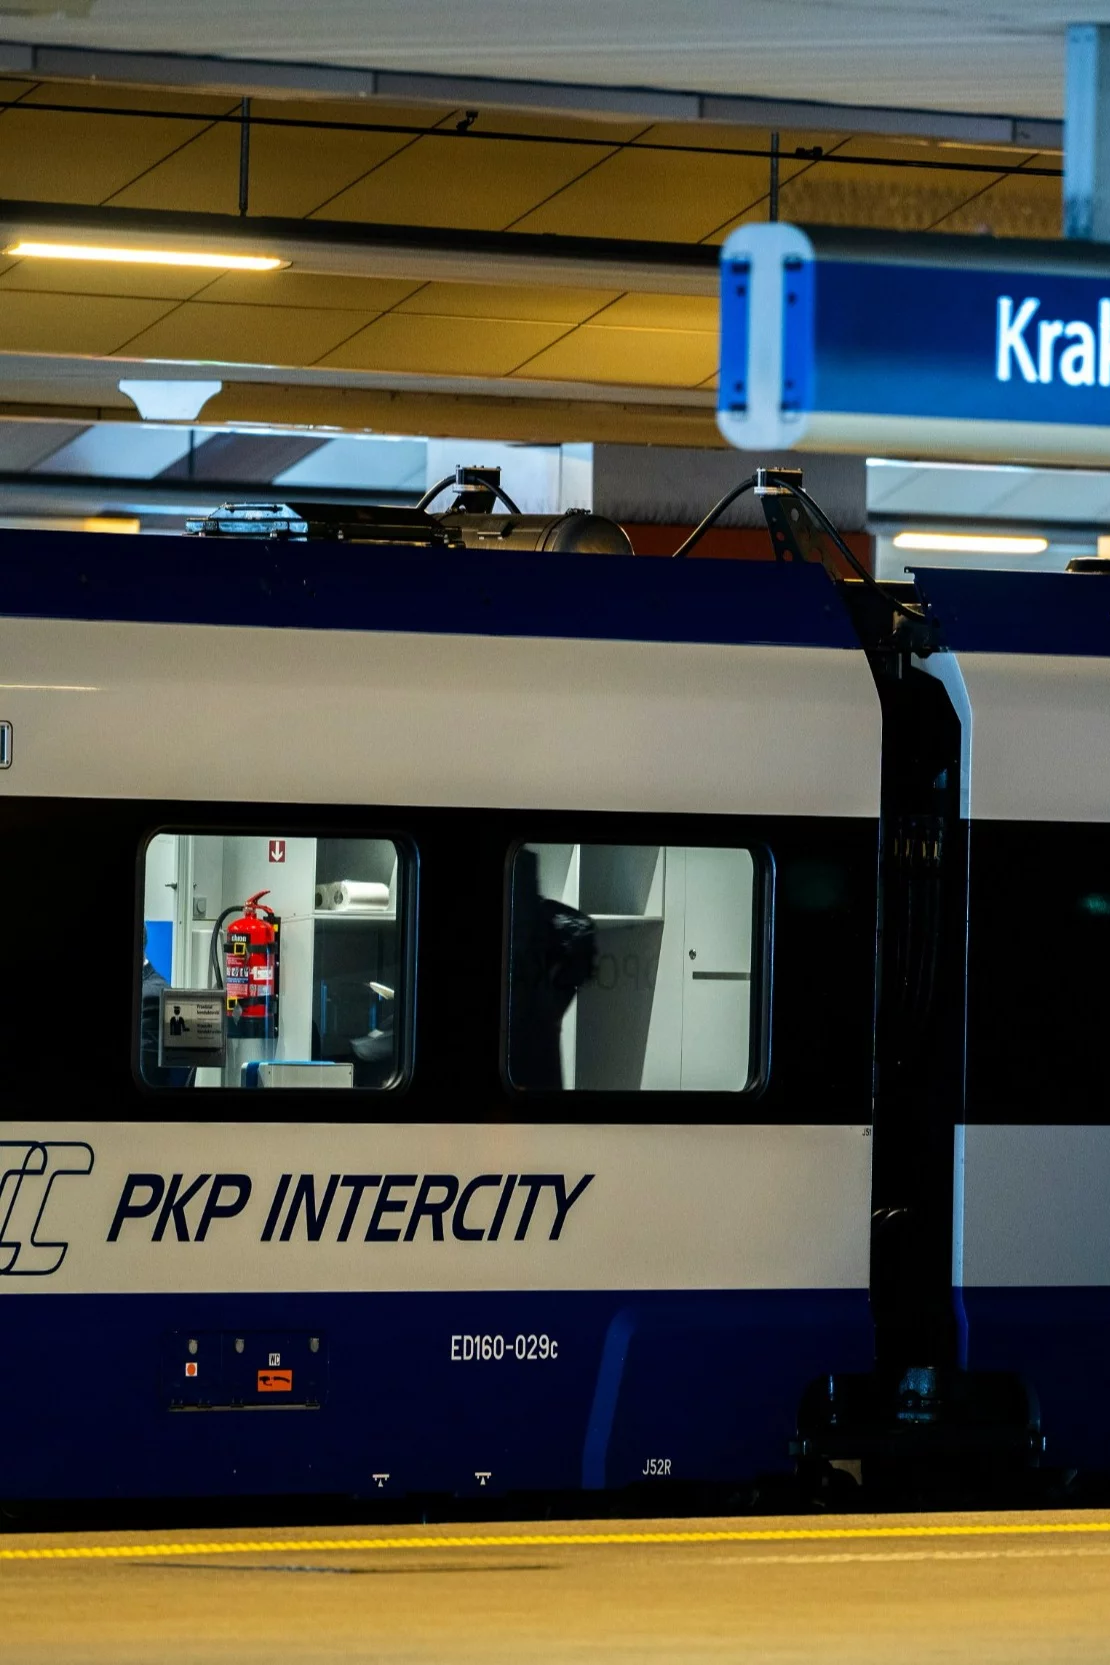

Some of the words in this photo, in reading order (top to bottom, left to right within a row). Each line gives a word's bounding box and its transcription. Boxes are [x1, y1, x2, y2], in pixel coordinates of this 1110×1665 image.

[106, 1173, 252, 1242] PKP
[260, 1173, 596, 1242] INTERCITY
[450, 1333, 559, 1361] ED160-029c
[270, 1354, 280, 1365] WC
[642, 1458, 672, 1476] J52R
